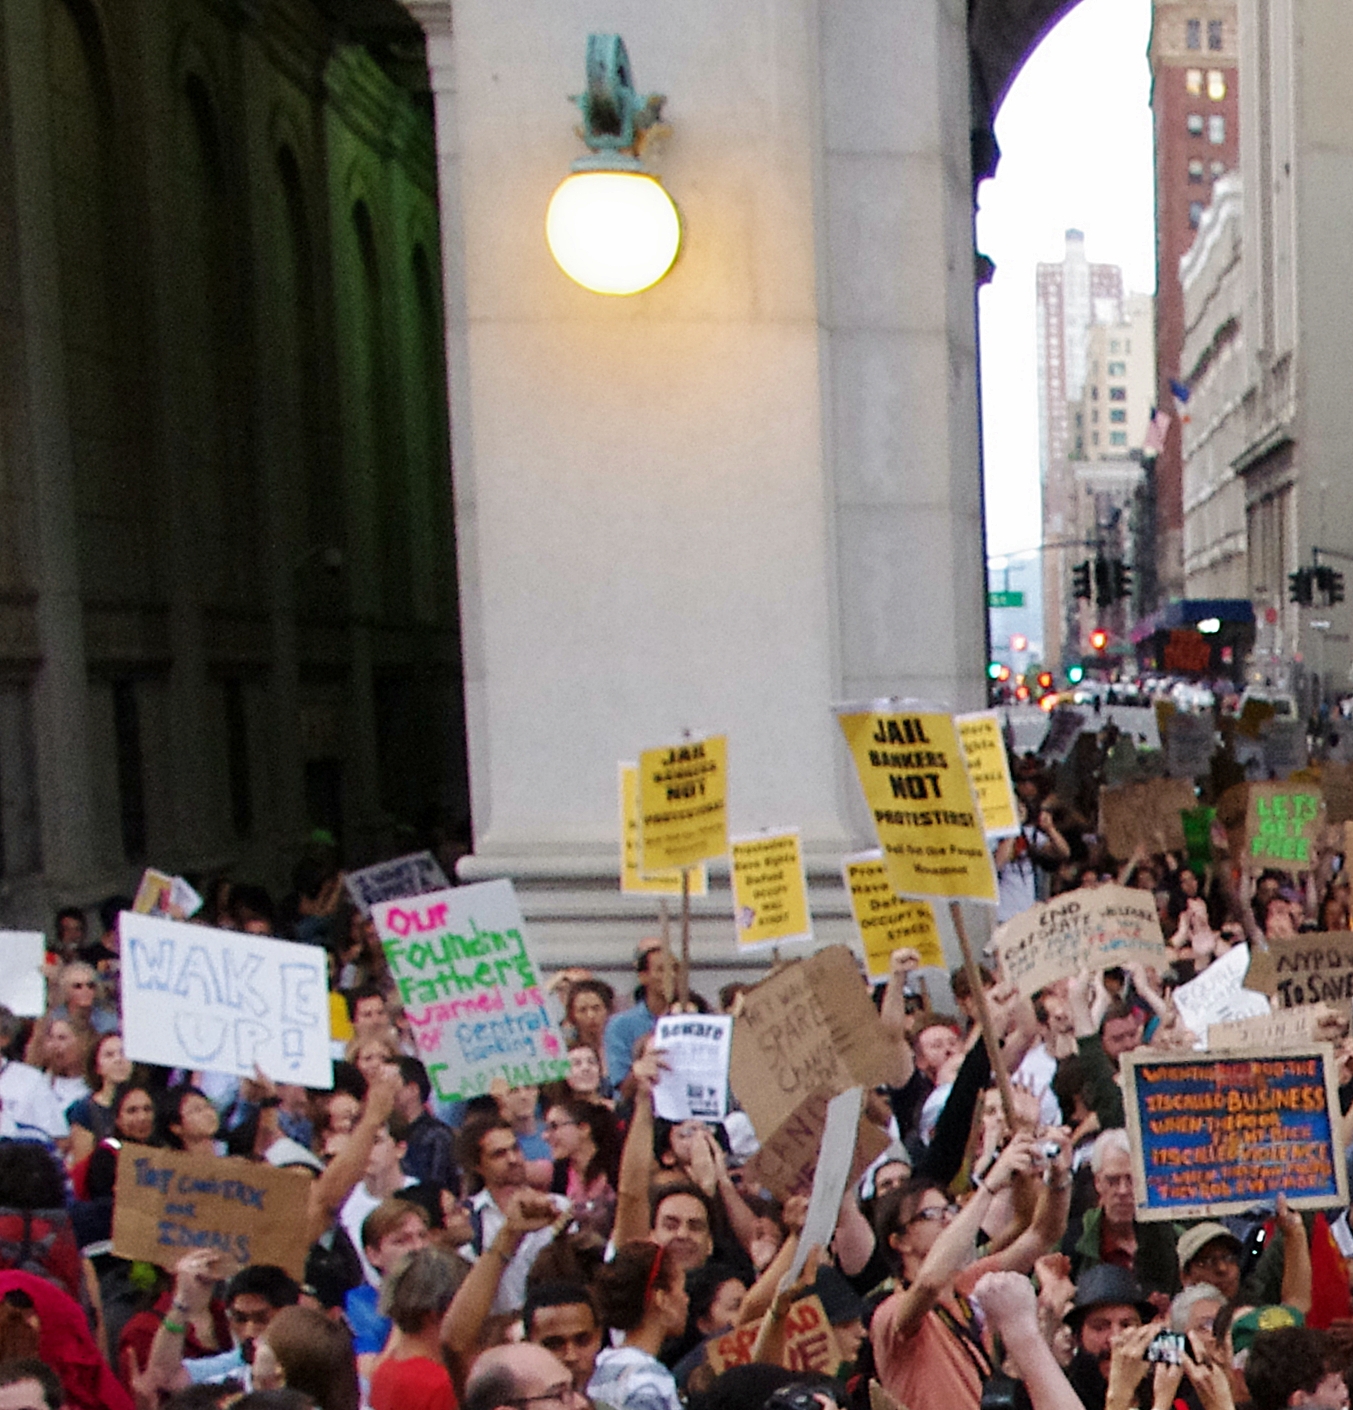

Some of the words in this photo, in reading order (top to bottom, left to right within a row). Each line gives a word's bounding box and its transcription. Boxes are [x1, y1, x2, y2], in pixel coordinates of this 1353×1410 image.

[873, 718, 930, 745] JAIL
[868, 749, 948, 769] BANKERS
[889, 773, 942, 799] NOT
[128, 936, 319, 1027] WAKE
[174, 1010, 305, 1070] UP!
[1226, 1085, 1325, 1113] BUSINESS
